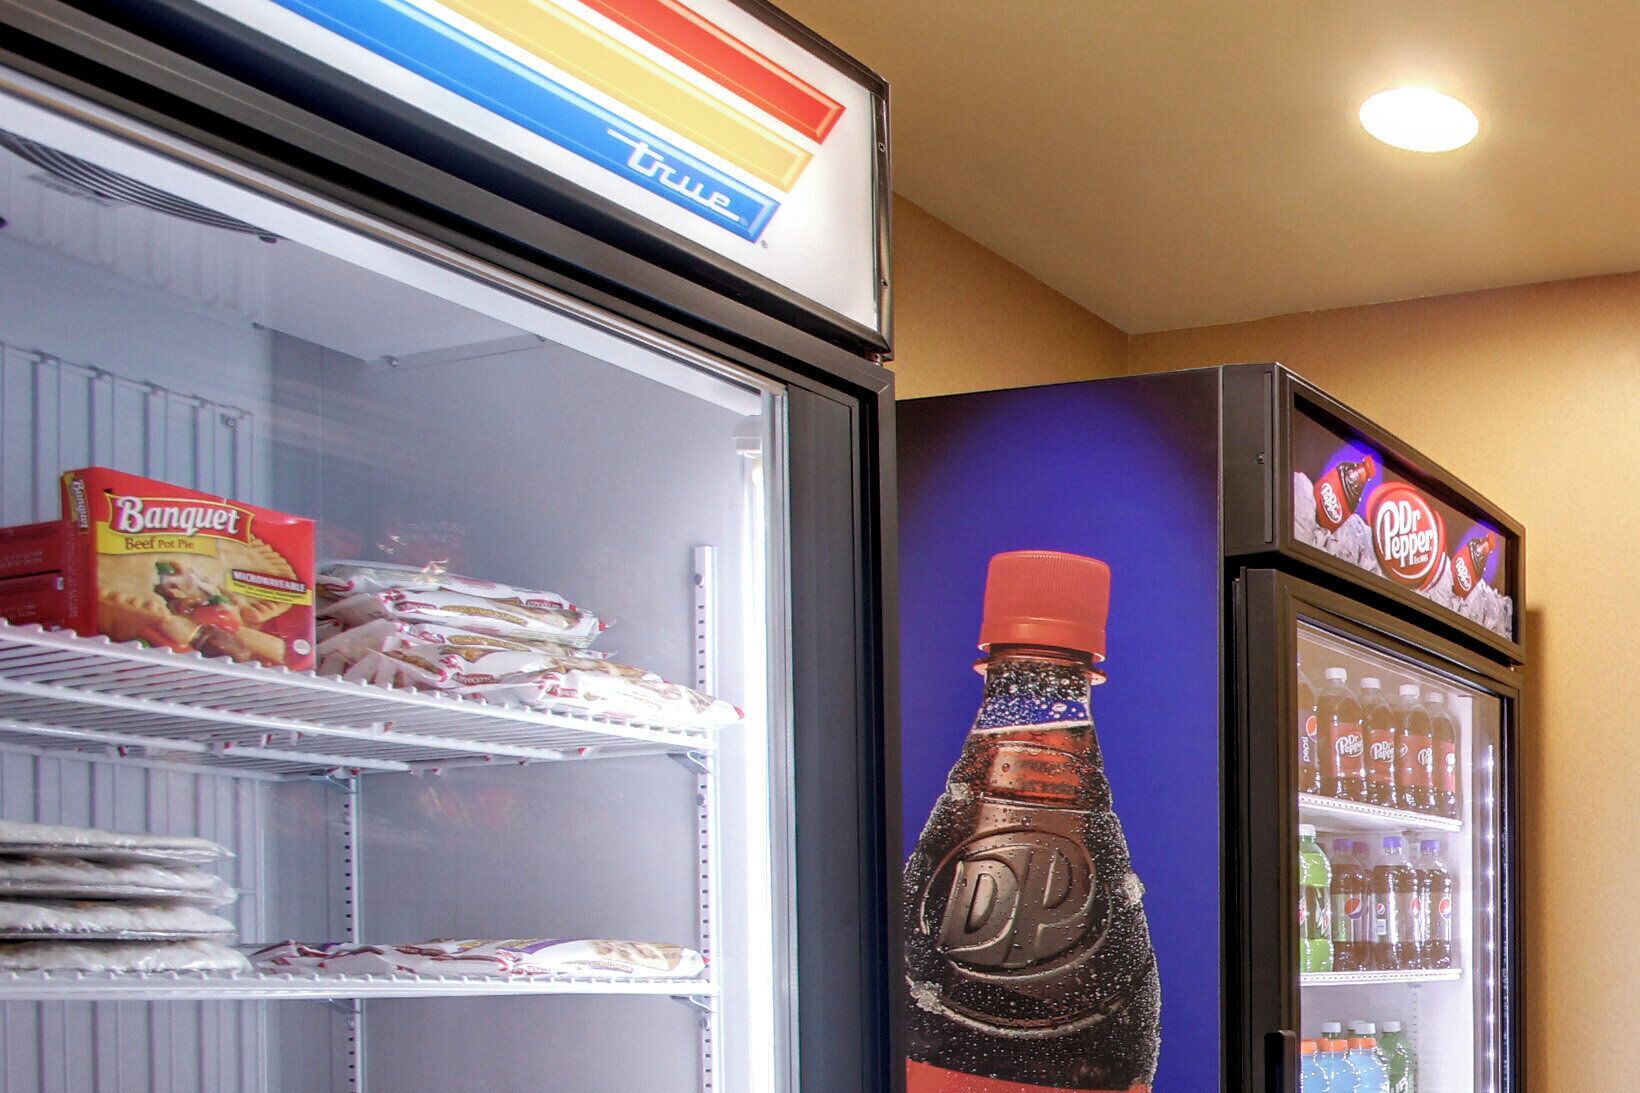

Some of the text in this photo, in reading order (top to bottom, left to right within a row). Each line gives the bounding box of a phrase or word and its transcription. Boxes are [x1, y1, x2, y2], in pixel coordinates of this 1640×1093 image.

[115, 495, 240, 537] Banquet
[1376, 499, 1435, 569] Pepper
[1398, 499, 1422, 532] Dr
[125, 536, 195, 550] Beef Pot Pie
